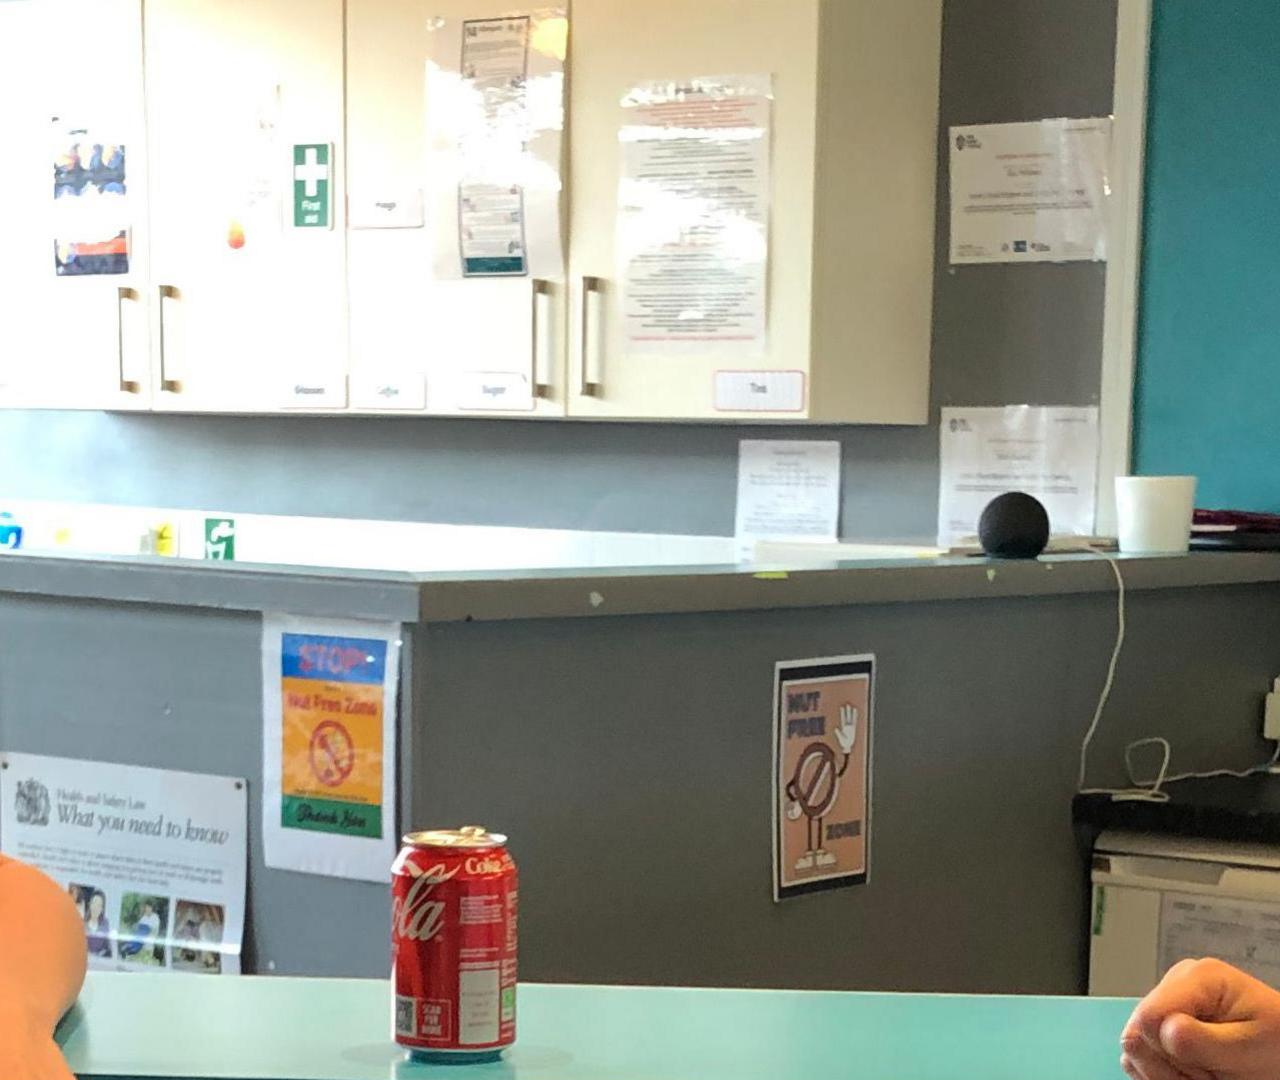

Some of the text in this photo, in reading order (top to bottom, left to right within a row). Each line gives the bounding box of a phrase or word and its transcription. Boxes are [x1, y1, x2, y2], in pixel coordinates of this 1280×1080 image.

[301, 199, 321, 211] First
[287, 693, 378, 716] Nut Free Zone
[787, 691, 821, 714] NUT
[788, 716, 826, 739] FREE
[56, 788, 147, 810] Health and Safety Law
[57, 802, 230, 845] What you need to know
[826, 820, 862, 841] ZONE
[464, 857, 502, 875] Coke
